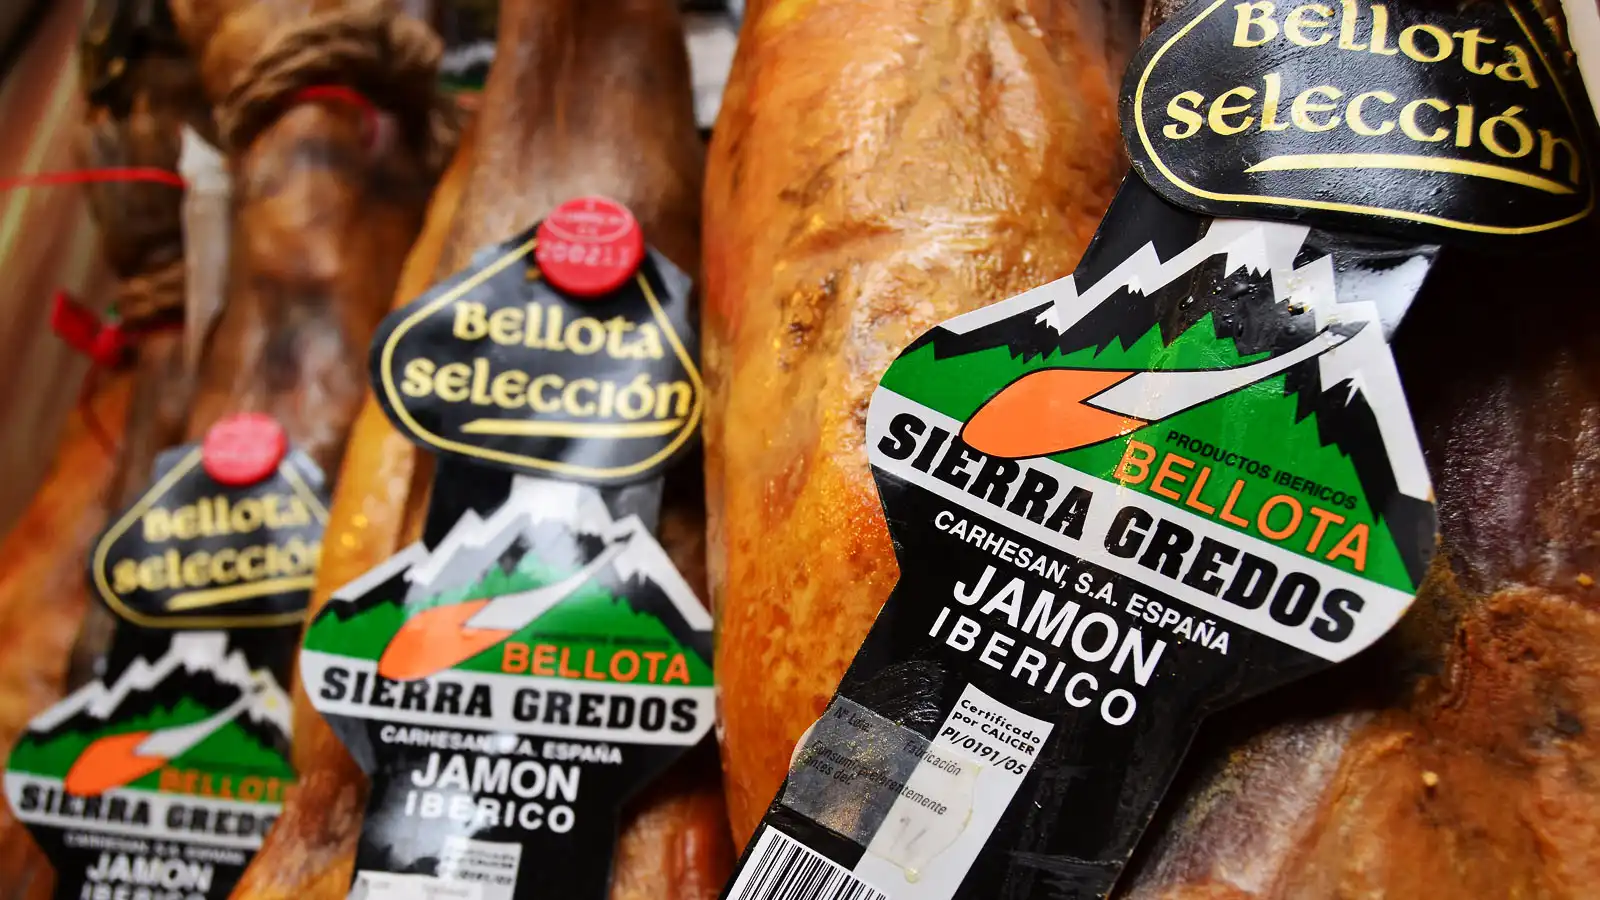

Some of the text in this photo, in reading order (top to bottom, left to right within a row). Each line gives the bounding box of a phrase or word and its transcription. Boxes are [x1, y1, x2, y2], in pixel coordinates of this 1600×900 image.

[1231, 0, 1541, 90] Bellota
[453, 301, 664, 360] Bellota
[1166, 430, 1358, 511] PRODUCTOS IBERICOS
[877, 413, 1366, 643] SIERRA GREDOS
[1112, 440, 1371, 573] BELLOTA
[934, 510, 1230, 656] CARHESAN, S.A. ESPAÑA
[953, 564, 1166, 687] JAMON
[501, 641, 690, 684] BELLOTA
[928, 607, 1137, 727] IBERICO
[320, 667, 698, 734] SIERRA GREDOS
[960, 699, 1041, 744] Certificado
[542, 742, 622, 764] ESPAÑA
[903, 740, 962, 776] Fabricación
[940, 726, 1027, 775] PI/0191/05
[952, 711, 1035, 756] por CALICER
[411, 752, 581, 802] JAMON
[405, 790, 575, 833] IBERICO
[85, 851, 214, 893] JAMON
